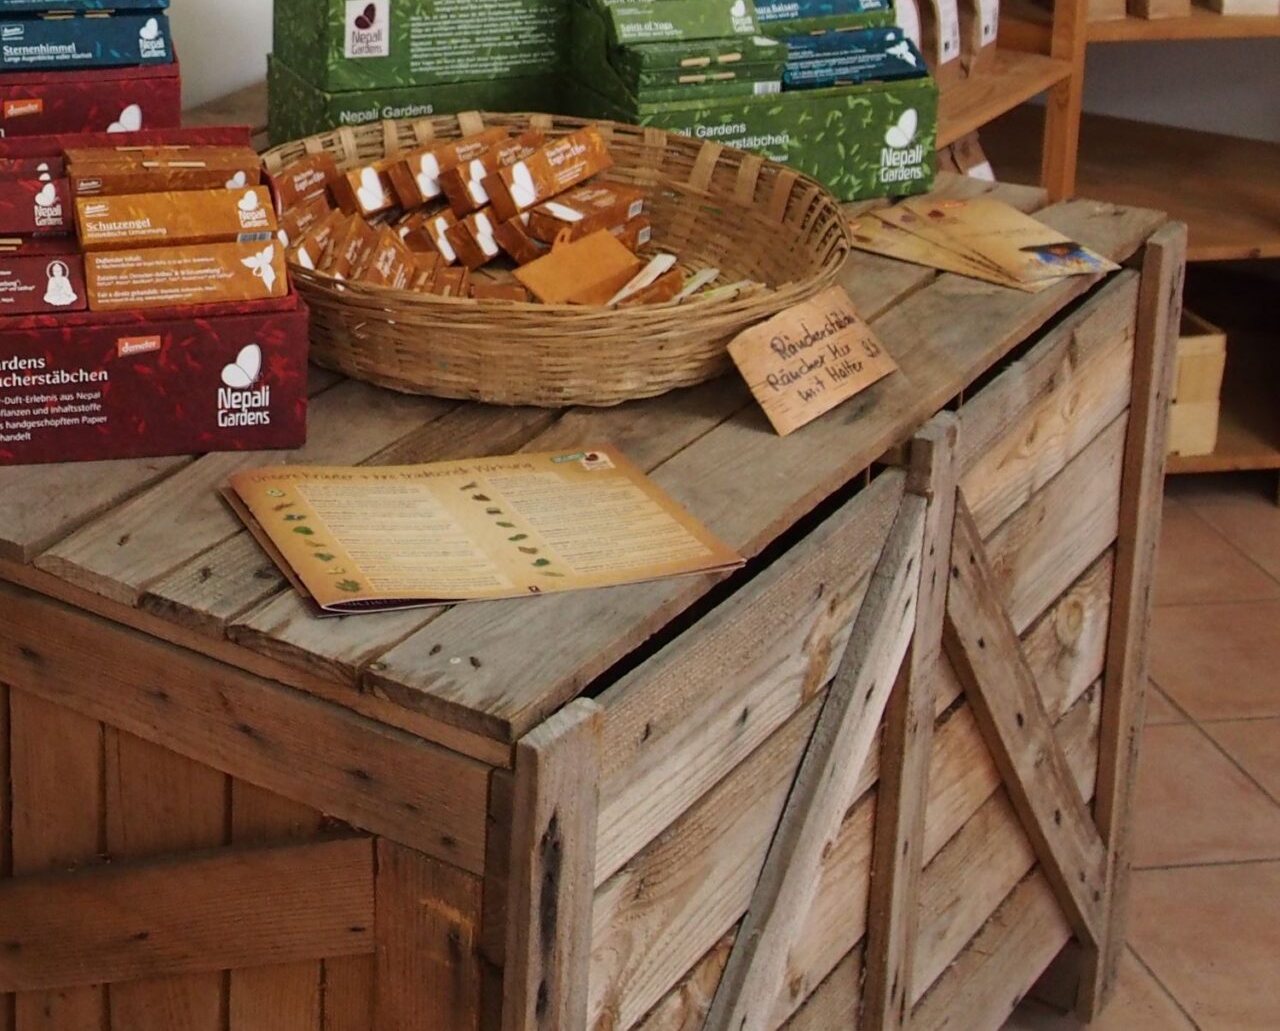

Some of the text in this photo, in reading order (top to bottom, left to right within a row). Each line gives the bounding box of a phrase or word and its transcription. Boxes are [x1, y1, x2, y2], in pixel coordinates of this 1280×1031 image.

[352, 30, 382, 45] Nepali
[3, 42, 76, 55] Sternenhimmel
[352, 44, 382, 55] Gardens
[341, 104, 433, 122] Nepali Gardens
[697, 123, 746, 137] Gardens
[881, 145, 922, 167] Nepali
[881, 166, 921, 182] Gardens
[34, 204, 62, 217] Nepali
[36, 216, 62, 226] Gardens
[86, 219, 151, 232] Schutzengel
[122, 341, 156, 353] demeter
[766, 353, 826, 391] Räucher
[827, 343, 851, 360] Mix
[797, 360, 864, 401] mit Halter
[76, 392, 100, 402] Nepal
[218, 386, 269, 411] Nepali
[33, 406, 48, 415] und
[6, 417, 80, 430] handgeschöpftem
[82, 416, 107, 425] Papier
[218, 409, 270, 427] Gardens
